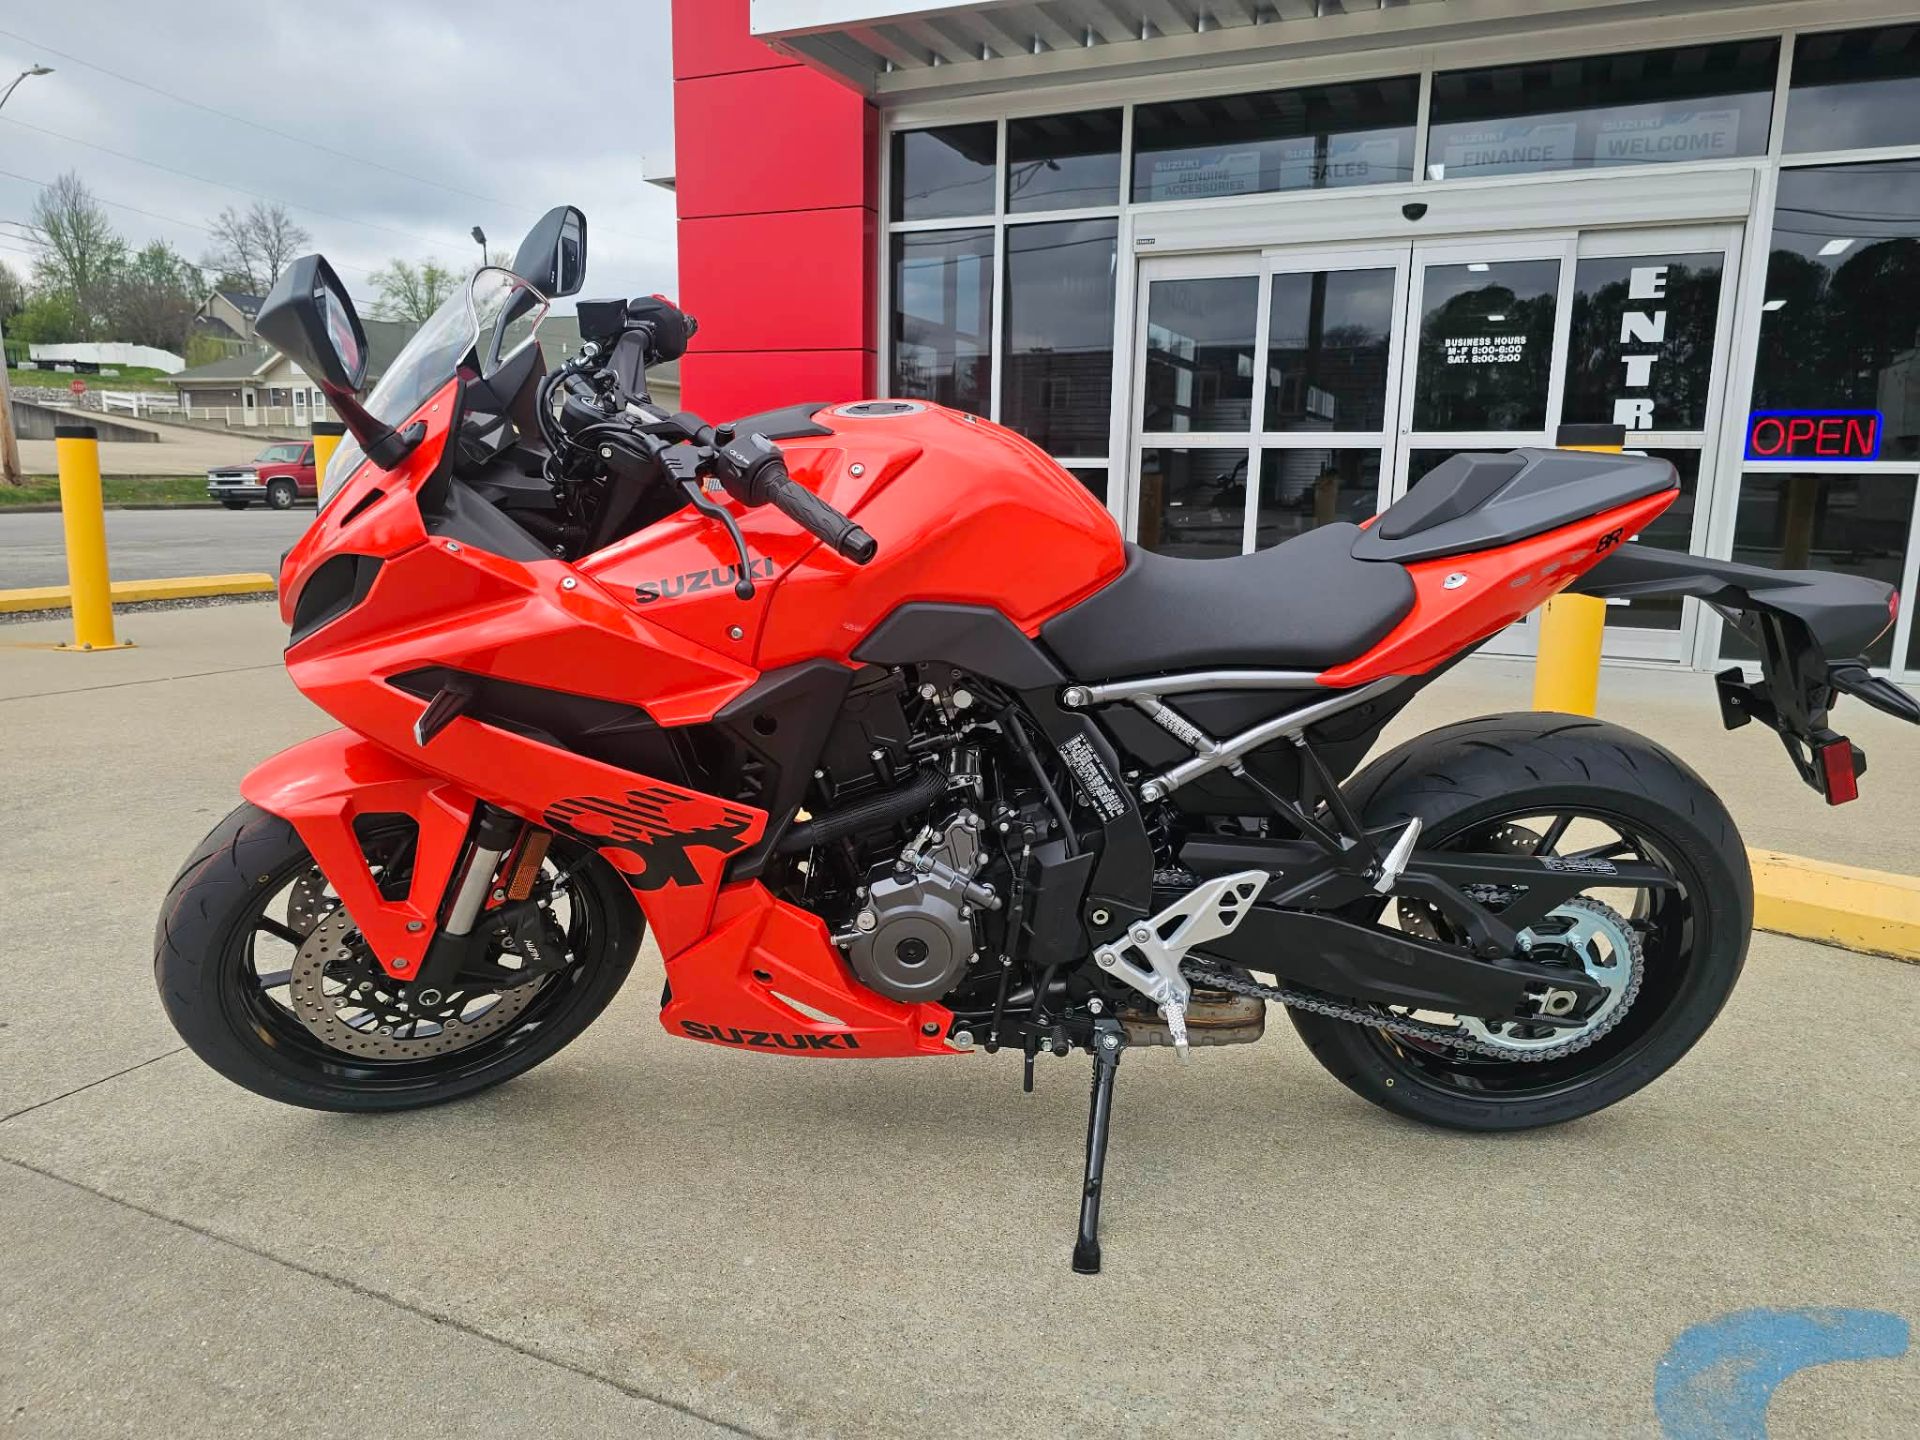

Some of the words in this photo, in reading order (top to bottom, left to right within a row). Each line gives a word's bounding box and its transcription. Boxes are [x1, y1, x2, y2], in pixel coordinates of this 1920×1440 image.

[1608, 131, 1725, 156] WELCOME
[1463, 145, 1554, 166] FINANCE
[1308, 161, 1368, 180] SALES
[1164, 180, 1244, 196] ACCESSORIES
[1445, 338, 1491, 347] BUSINESS
[1494, 336, 1527, 345] HOURS
[1447, 347, 1468, 355] M-F
[1447, 355, 1469, 364] SAT.
[1752, 418, 1876, 455] OPEN
[1596, 528, 1624, 553] 8R
[635, 556, 774, 604] SUZUKI
[680, 1020, 861, 1050] SUZUKI
